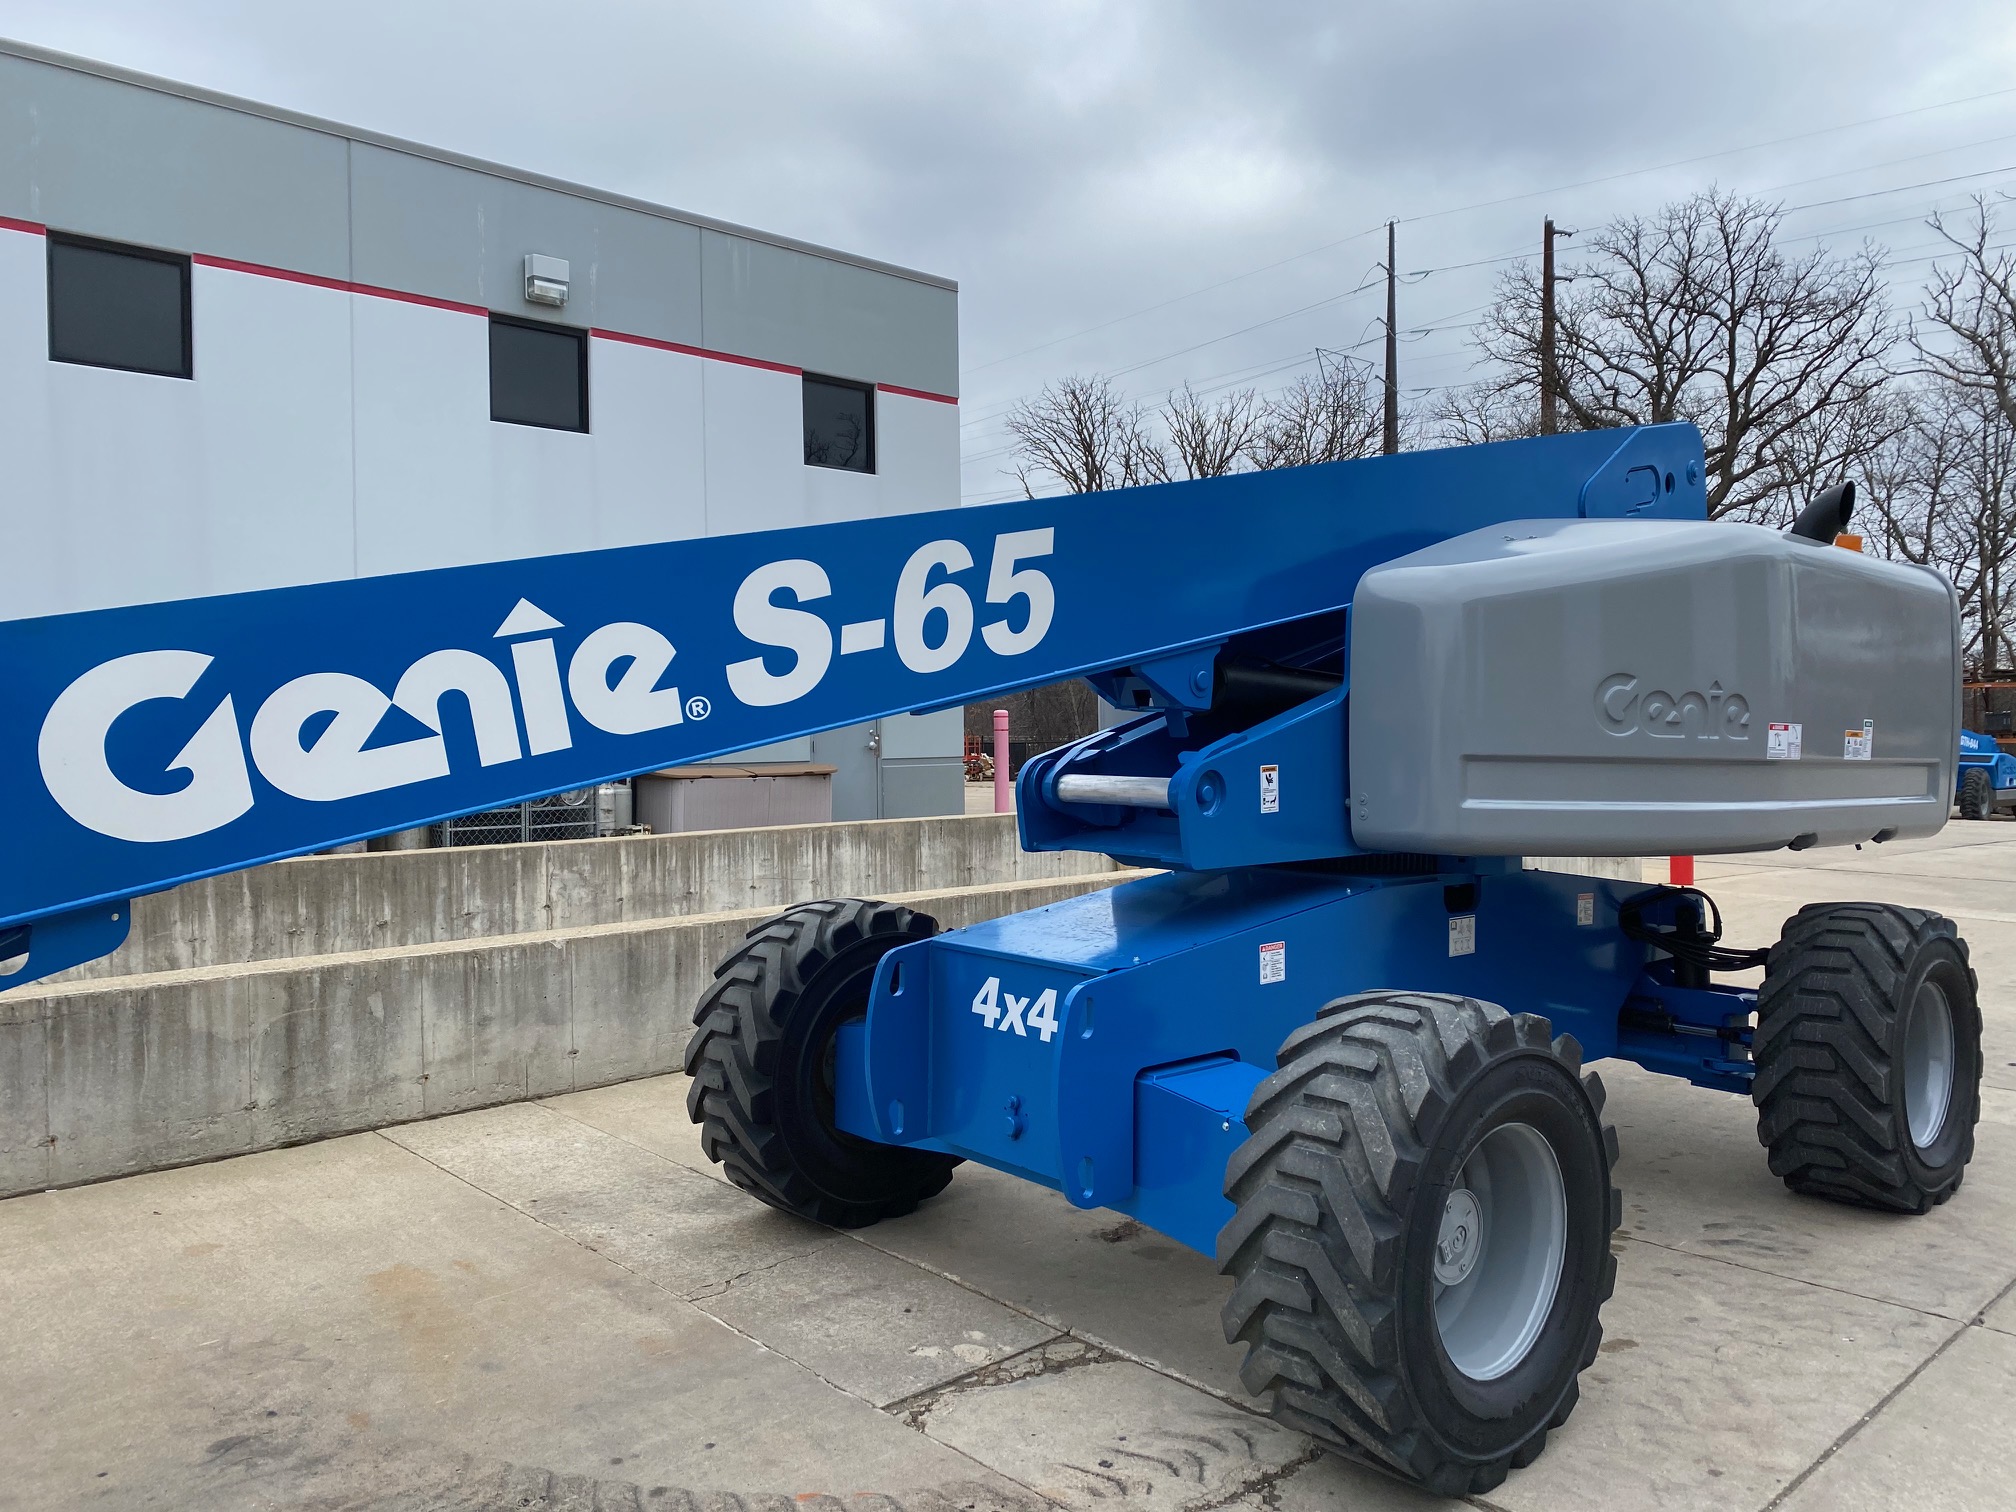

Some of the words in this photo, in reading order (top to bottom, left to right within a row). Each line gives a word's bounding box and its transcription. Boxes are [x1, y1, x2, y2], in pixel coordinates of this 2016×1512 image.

[38, 597, 684, 842] Genie
[726, 526, 1055, 707] S-65
[1594, 672, 1750, 740] Genie
[971, 976, 1059, 1043] 4x4
